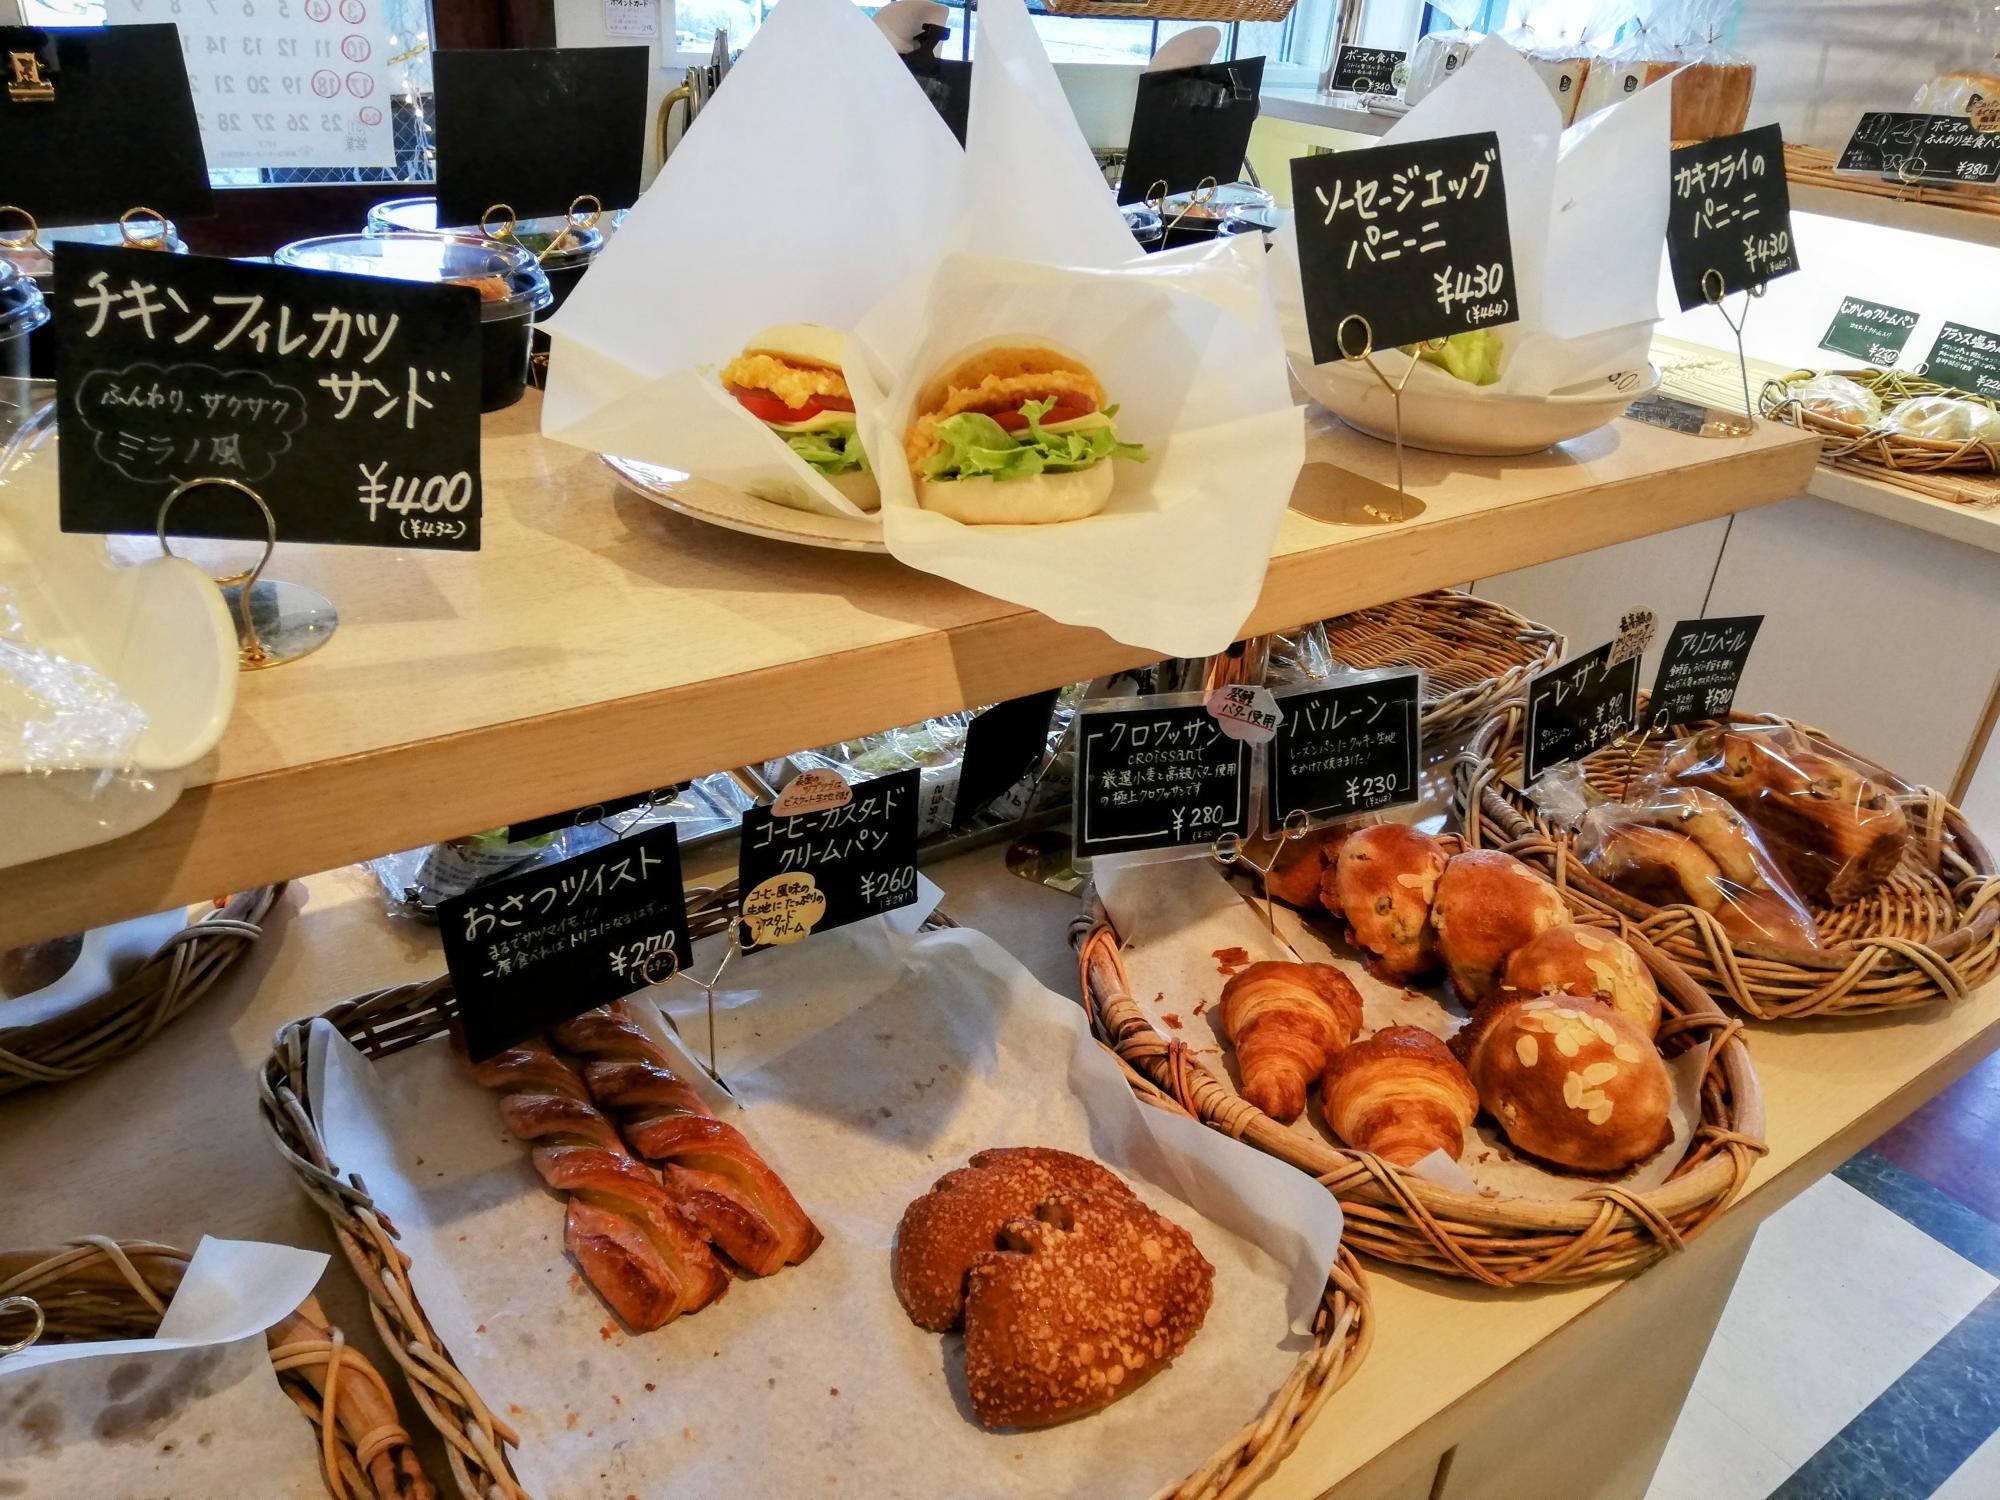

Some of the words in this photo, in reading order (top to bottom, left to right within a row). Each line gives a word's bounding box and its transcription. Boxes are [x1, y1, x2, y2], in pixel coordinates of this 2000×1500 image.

[1931, 118, 1969, 133] ボーヌの
[1315, 148, 1497, 225] ソーセージエッグ
[1674, 148, 1765, 199] カキフライの
[1956, 161, 1988, 176] ¥380
[1694, 193, 1760, 239] パニーニ
[1347, 221, 1447, 270] パニーニ
[1743, 231, 1788, 273] ¥430
[1433, 263, 1504, 314] ¥430
[74, 271, 399, 363] チキンフィレカツ
[1466, 300, 1509, 324] (¥464)
[1840, 300, 1916, 329] むかしのクリームパン
[319, 367, 451, 428] サンド
[117, 432, 246, 470] ミラノ風
[358, 461, 472, 522] ¥400
[400, 518, 467, 540] (¥432)
[1677, 627, 1747, 658] アリコベール
[1222, 702, 1276, 729] バター使用
[1290, 695, 1388, 738] バルーン
[1704, 688, 1734, 710] ¥580
[1109, 718, 1223, 752] クロワッサン
[1100, 782, 1203, 807] の極上クロワッサンです
[1345, 772, 1397, 805] ¥230
[752, 786, 906, 849] コーヒーカスタード
[779, 828, 889, 873] クリームパン
[463, 846, 662, 942] おさつツイスト
[749, 881, 810, 902] コーヒー風味の
[860, 865, 915, 903] ¥260
[609, 929, 676, 976] ¥270
